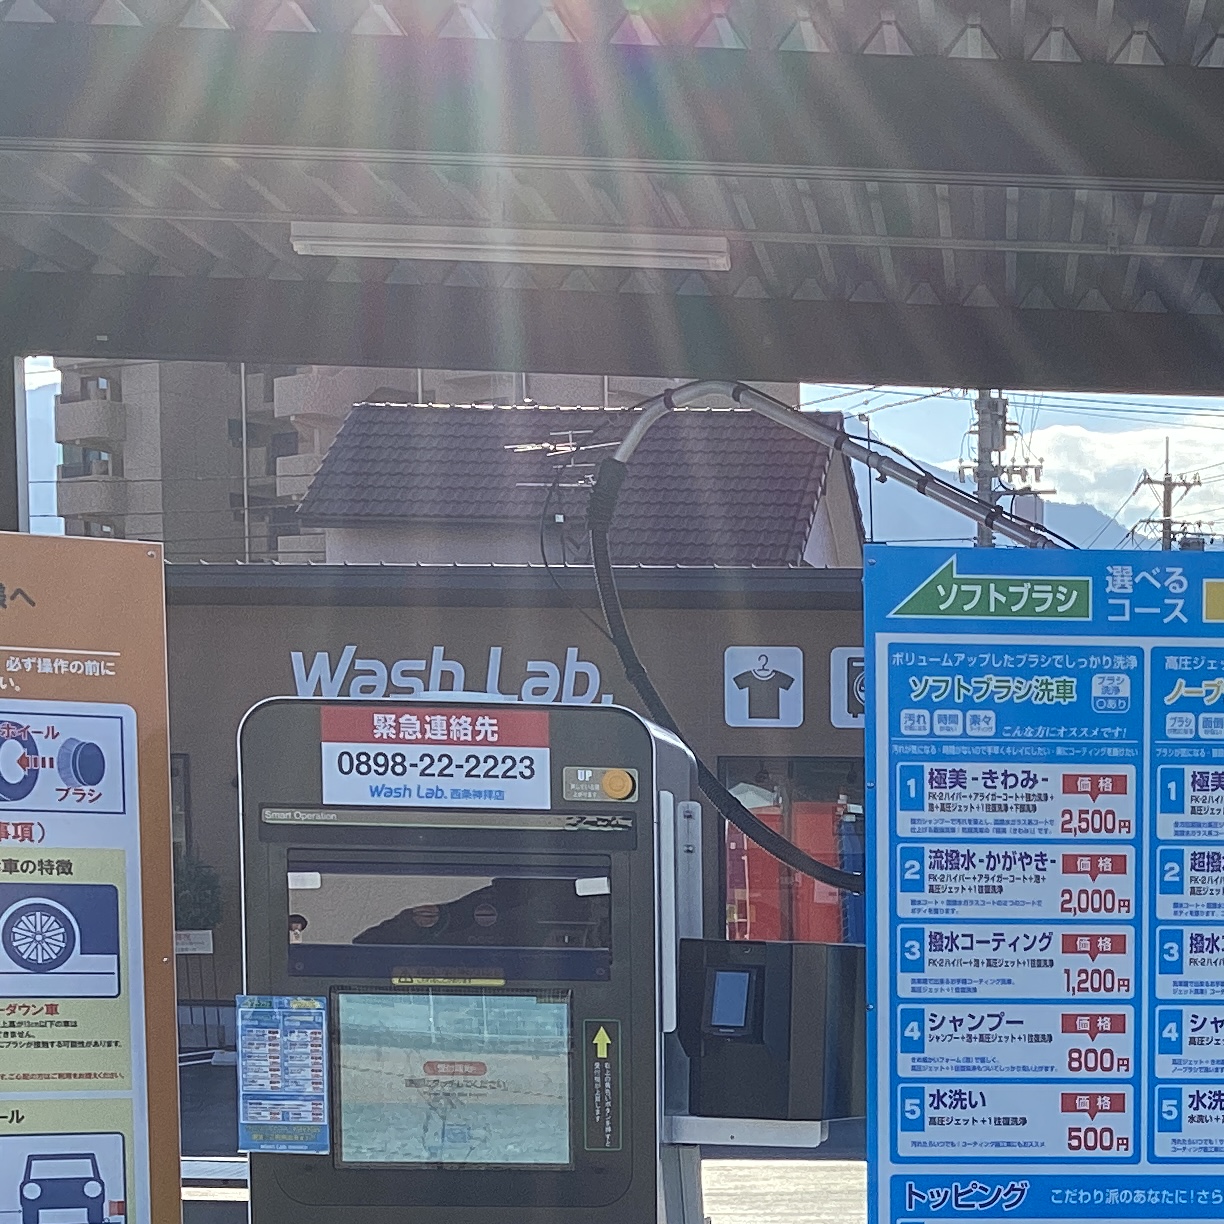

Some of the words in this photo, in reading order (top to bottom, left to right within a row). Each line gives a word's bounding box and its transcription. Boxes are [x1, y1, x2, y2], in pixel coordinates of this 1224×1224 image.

[1105, 564, 1188, 594] 選べる
[936, 582, 1078, 613] ソフトブラシ
[1106, 597, 1188, 624] コース
[6, 656, 117, 677] 必ず操作の前に
[892, 652, 1138, 670] ボリュームアップしたブラシでしっかり洗浄
[291, 646, 465, 698] Wash
[1097, 676, 1125, 686] ブラシ
[909, 675, 1077, 705] ソフトブラシ洗車
[373, 713, 500, 742] 緊急連絡先
[904, 713, 928, 726] 汚れ
[937, 714, 960, 726] 時間
[1169, 716, 1193, 728] ブラシ
[1002, 726, 1127, 739] こんな方にオススメです!
[336, 751, 536, 780] 0898-22-2223
[577, 770, 593, 781] UP
[905, 777, 917, 799] 1
[928, 767, 1049, 790] 極美-きわみ-
[1076, 776, 1114, 793] 価格
[55, 787, 103, 803] ブラシ
[369, 783, 412, 799] Wash
[416, 785, 449, 800] Lab.
[1166, 780, 1178, 801] 1
[264, 810, 292, 820] Smart
[293, 811, 337, 823] Operation
[1060, 808, 1132, 837] 2,500円
[0, 858, 74, 876] 車の特徴
[903, 860, 922, 880] 2
[1076, 856, 1114, 872] 価格
[1163, 861, 1180, 881] 2
[1060, 888, 1131, 917] 2,000円
[904, 939, 921, 960] 3
[928, 930, 1054, 953] 撥水コーティング
[1076, 936, 1112, 952] 価格
[1162, 941, 1179, 962] 3
[1062, 968, 1130, 996] 1,200円
[903, 1021, 921, 1041] 4
[928, 1011, 1024, 1033] シャンプー
[1075, 1016, 1112, 1031] 価格
[1161, 1021, 1178, 1042] 4
[1067, 1048, 1130, 1073] 800円
[904, 1098, 922, 1120] 5
[928, 1089, 986, 1110] 水洗い
[1075, 1095, 1111, 1110] 価格
[1161, 1099, 1178, 1120] 5
[1067, 1126, 1129, 1151] 500円
[905, 1179, 1030, 1211] トッピング
